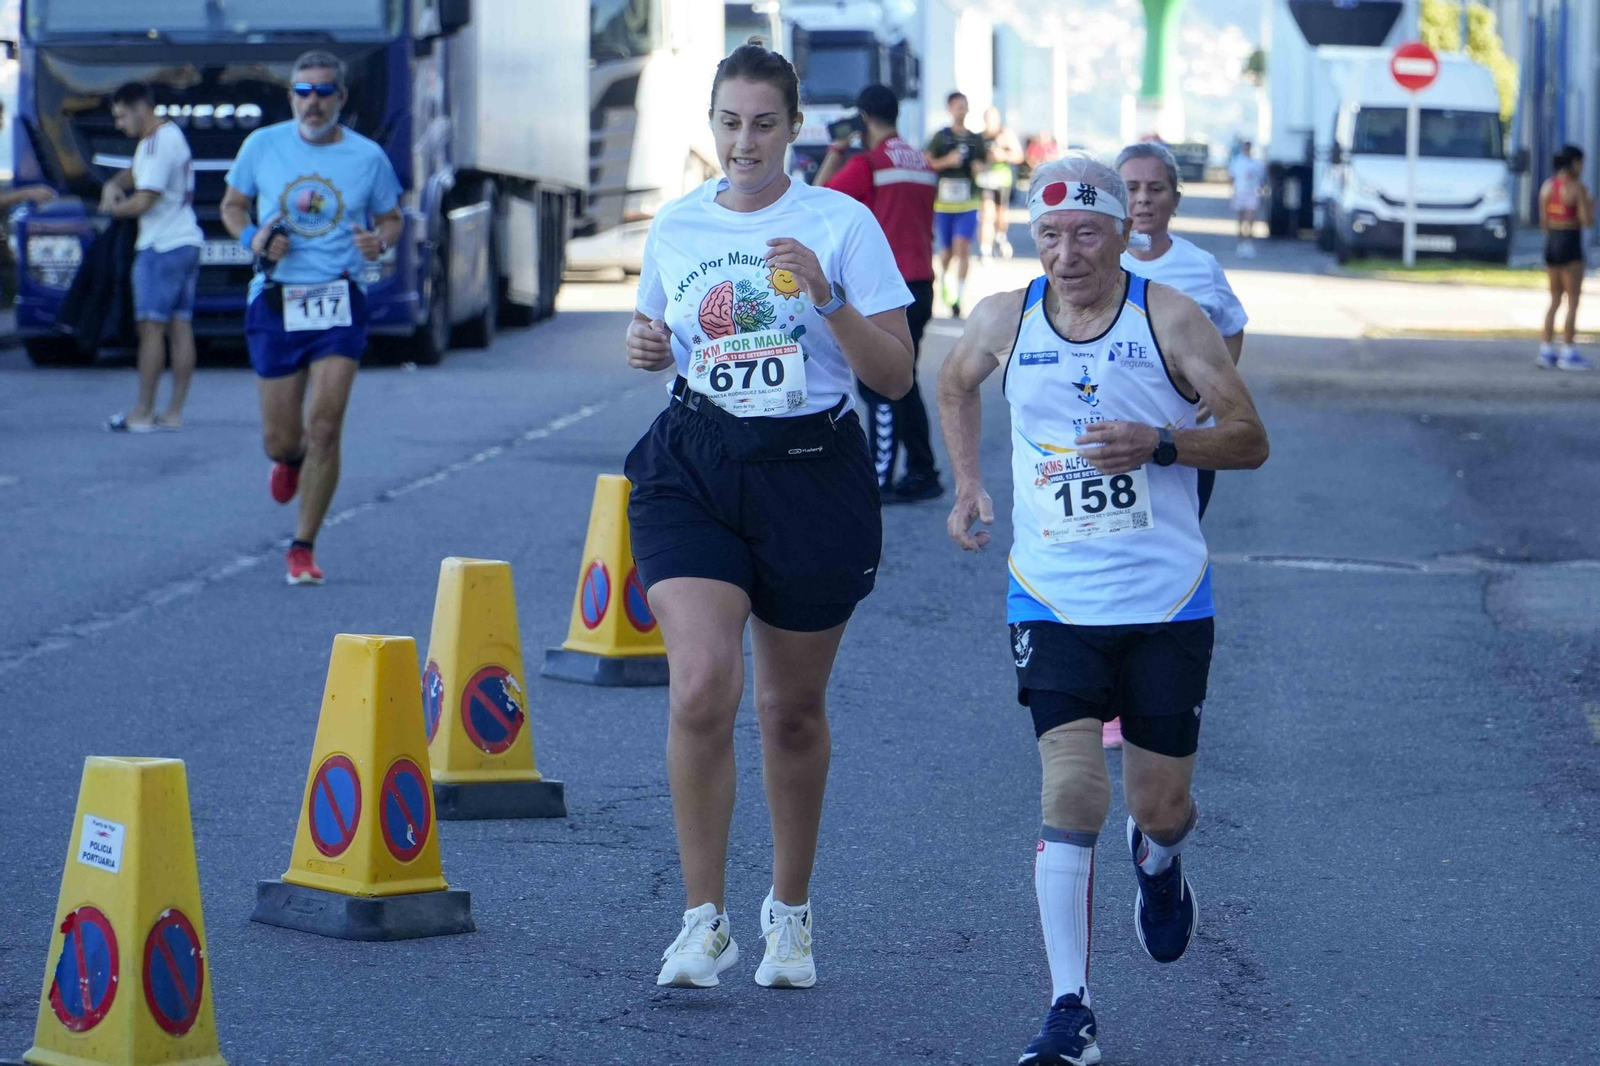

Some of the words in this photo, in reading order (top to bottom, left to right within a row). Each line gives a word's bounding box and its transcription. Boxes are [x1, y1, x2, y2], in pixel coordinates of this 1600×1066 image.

[674, 270, 699, 302] 5Km
[699, 258, 723, 275] por
[299, 297, 342, 318] 117
[695, 343, 721, 361] 5KM
[724, 339, 751, 352] POR
[746, 349, 775, 359] SETEMBRO
[709, 356, 785, 392] 670
[1120, 359, 1155, 370] seguros
[1035, 459, 1063, 476] 10KMS
[1065, 456, 1092, 470] ALFO
[1054, 474, 1137, 517] 158
[90, 840, 112, 855] POLICIA
[82, 851, 115, 868] PORTUARIA
